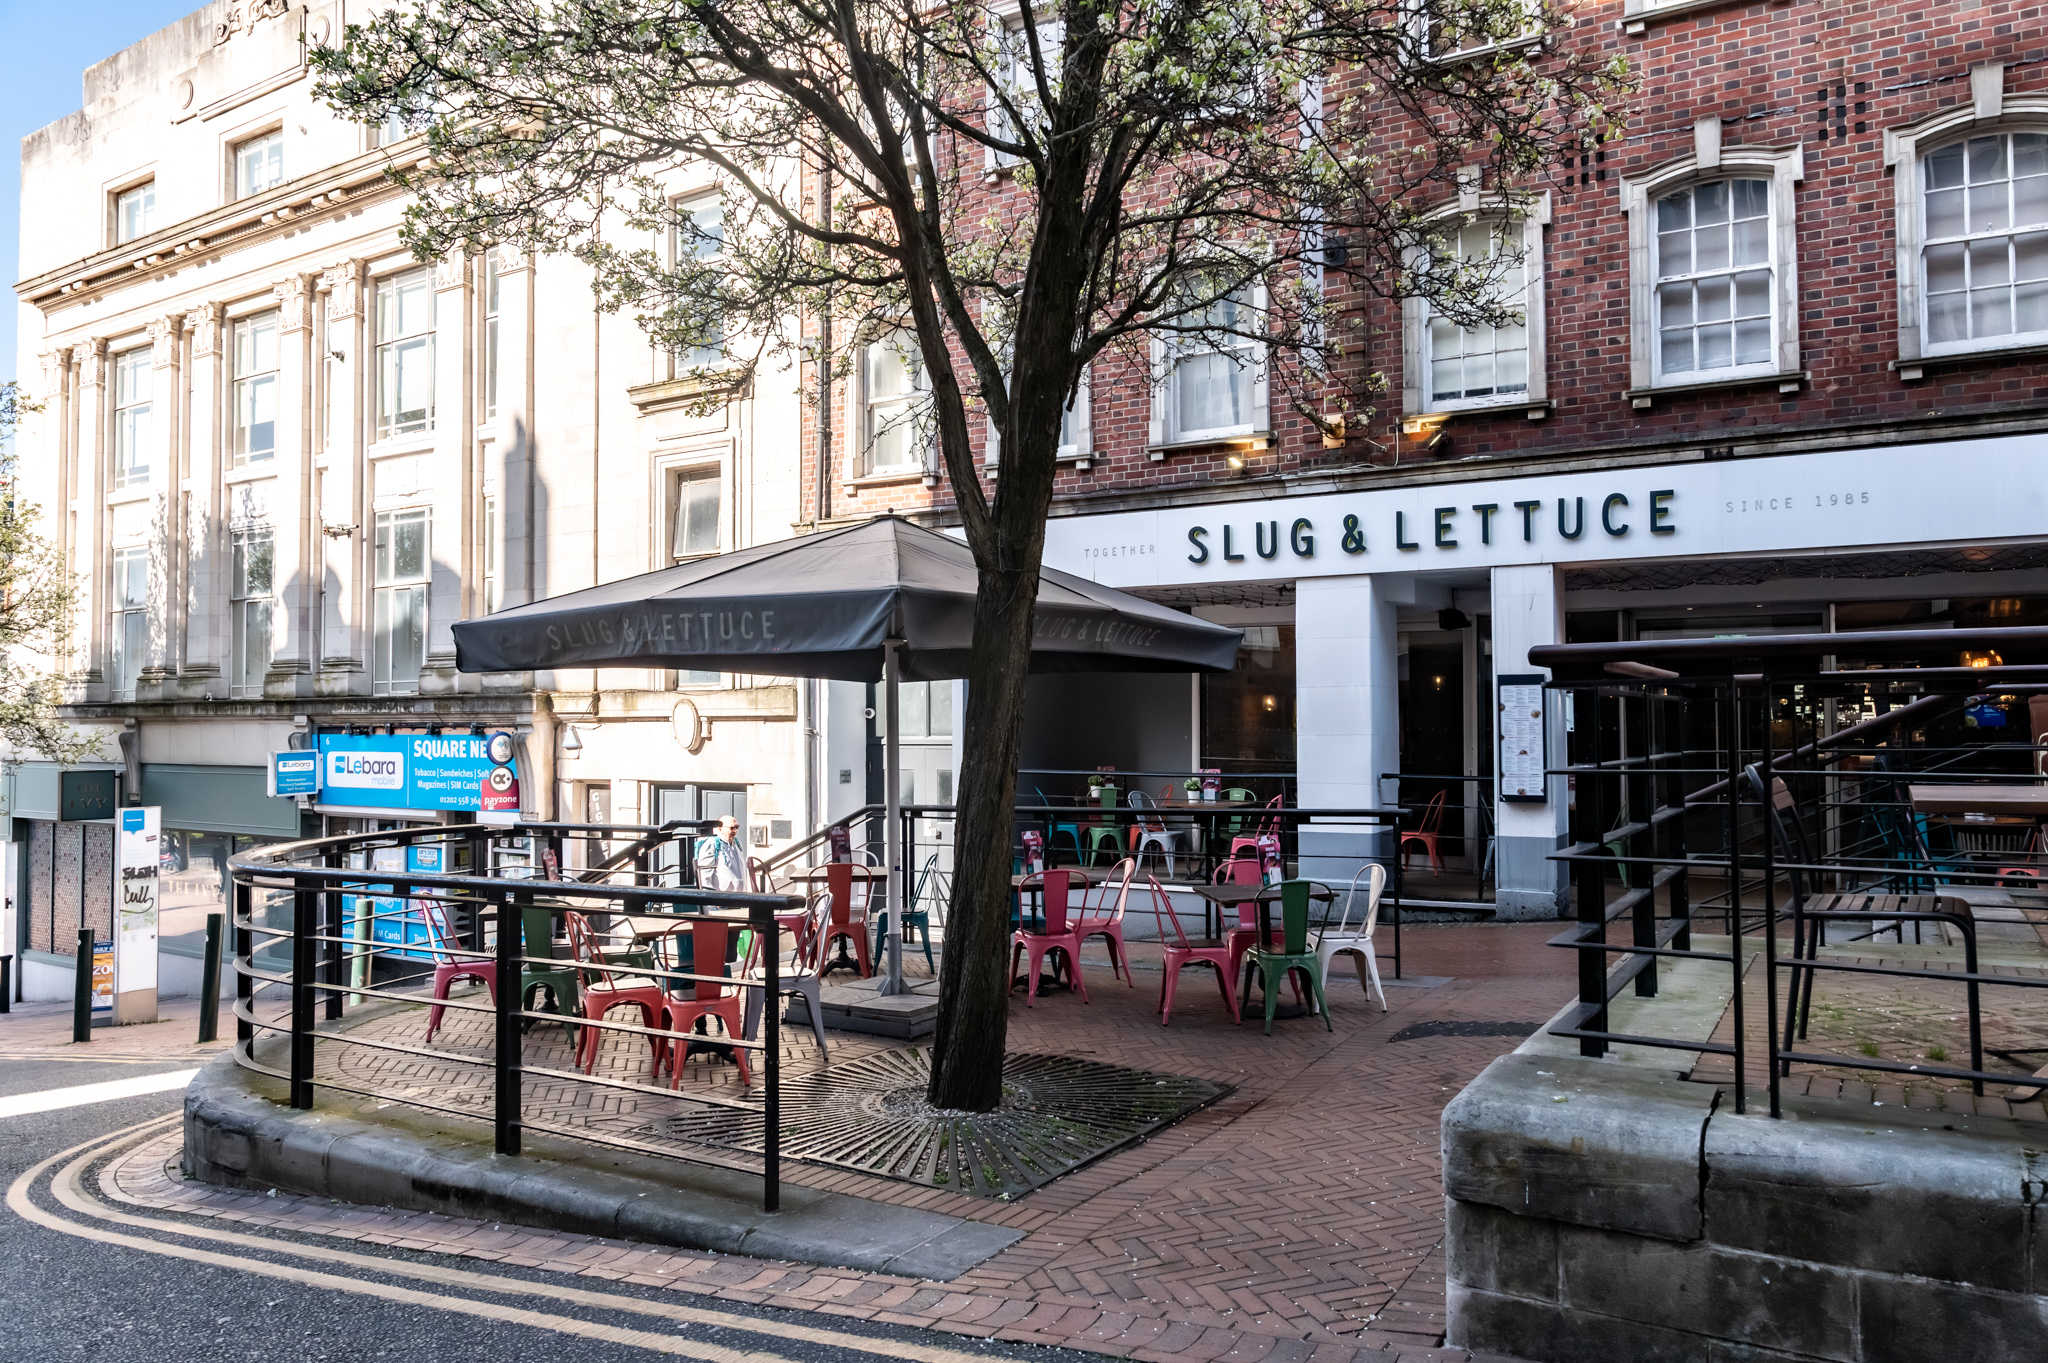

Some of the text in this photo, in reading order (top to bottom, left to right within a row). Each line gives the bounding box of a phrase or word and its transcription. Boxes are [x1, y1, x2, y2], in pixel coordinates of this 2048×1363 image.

[1725, 491, 1870, 514] SINCE 1985
[1187, 488, 1676, 564] SLUG & LETTUCE
[1084, 544, 1156, 558] TOGETHER
[546, 610, 776, 651] SLUG & LETTUCE
[1077, 619, 1092, 640] &
[1095, 620, 1161, 646] LETTUCE
[325, 737, 331, 746] 6
[413, 740, 488, 760] SQUARE NE
[346, 756, 396, 775] Lebara
[414, 768, 490, 778] Tobacco Sandwiches Soft
[372, 776, 395, 786] mobile
[417, 780, 479, 790] Magazines SIM Cards
[458, 796, 469, 805] 558
[484, 796, 517, 806] payzone
[168, 880, 217, 897] THE IVY
[253, 890, 268, 903] HE
[384, 930, 401, 941] Cards
